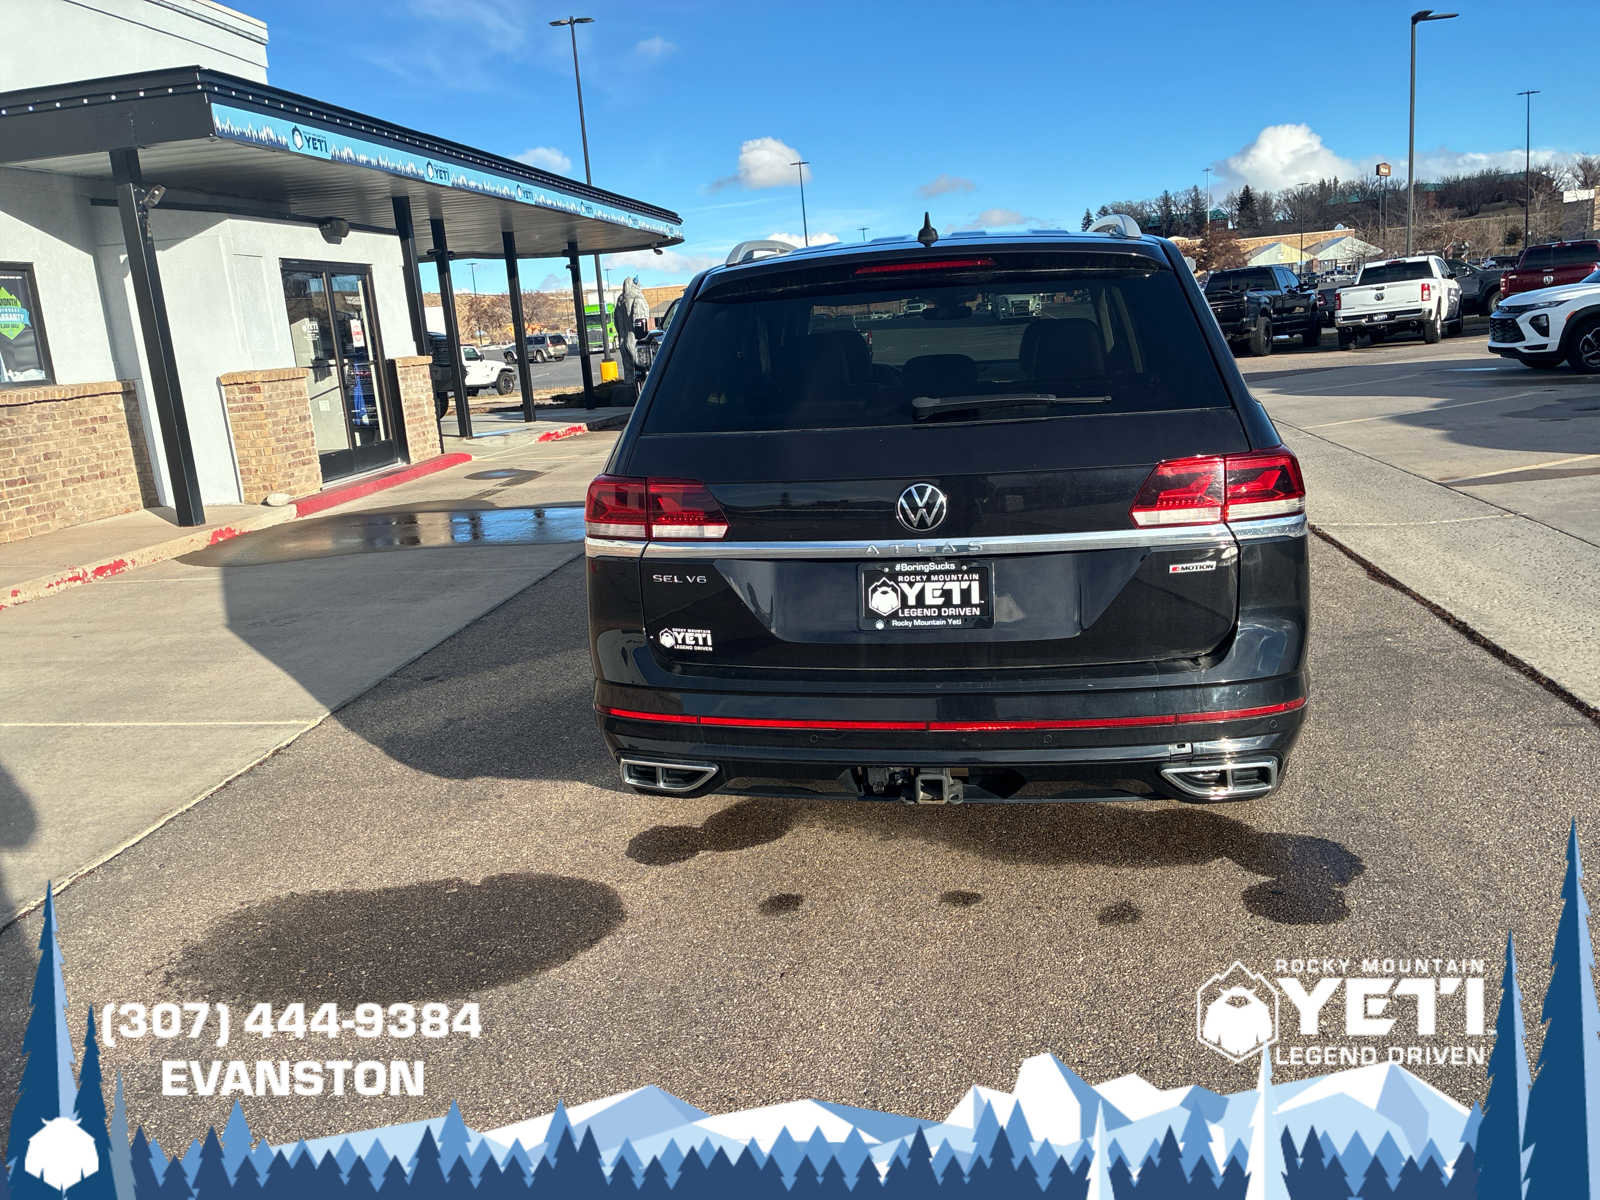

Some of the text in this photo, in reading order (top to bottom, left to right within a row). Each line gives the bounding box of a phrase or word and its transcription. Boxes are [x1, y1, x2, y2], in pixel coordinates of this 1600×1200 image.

[304, 135, 328, 153] YETI
[433, 168, 450, 180] YETI
[865, 541, 983, 554] ATLAS
[895, 562, 956, 573] #BoringSucks
[652, 574, 707, 584] SEL V6
[931, 573, 980, 581] MOUNTAIN
[899, 581, 980, 606] YETI
[899, 607, 981, 617] LEGEND DRIVEN
[892, 620, 913, 628] Rocky
[914, 619, 946, 627] Mountain
[673, 631, 712, 646] YETI
